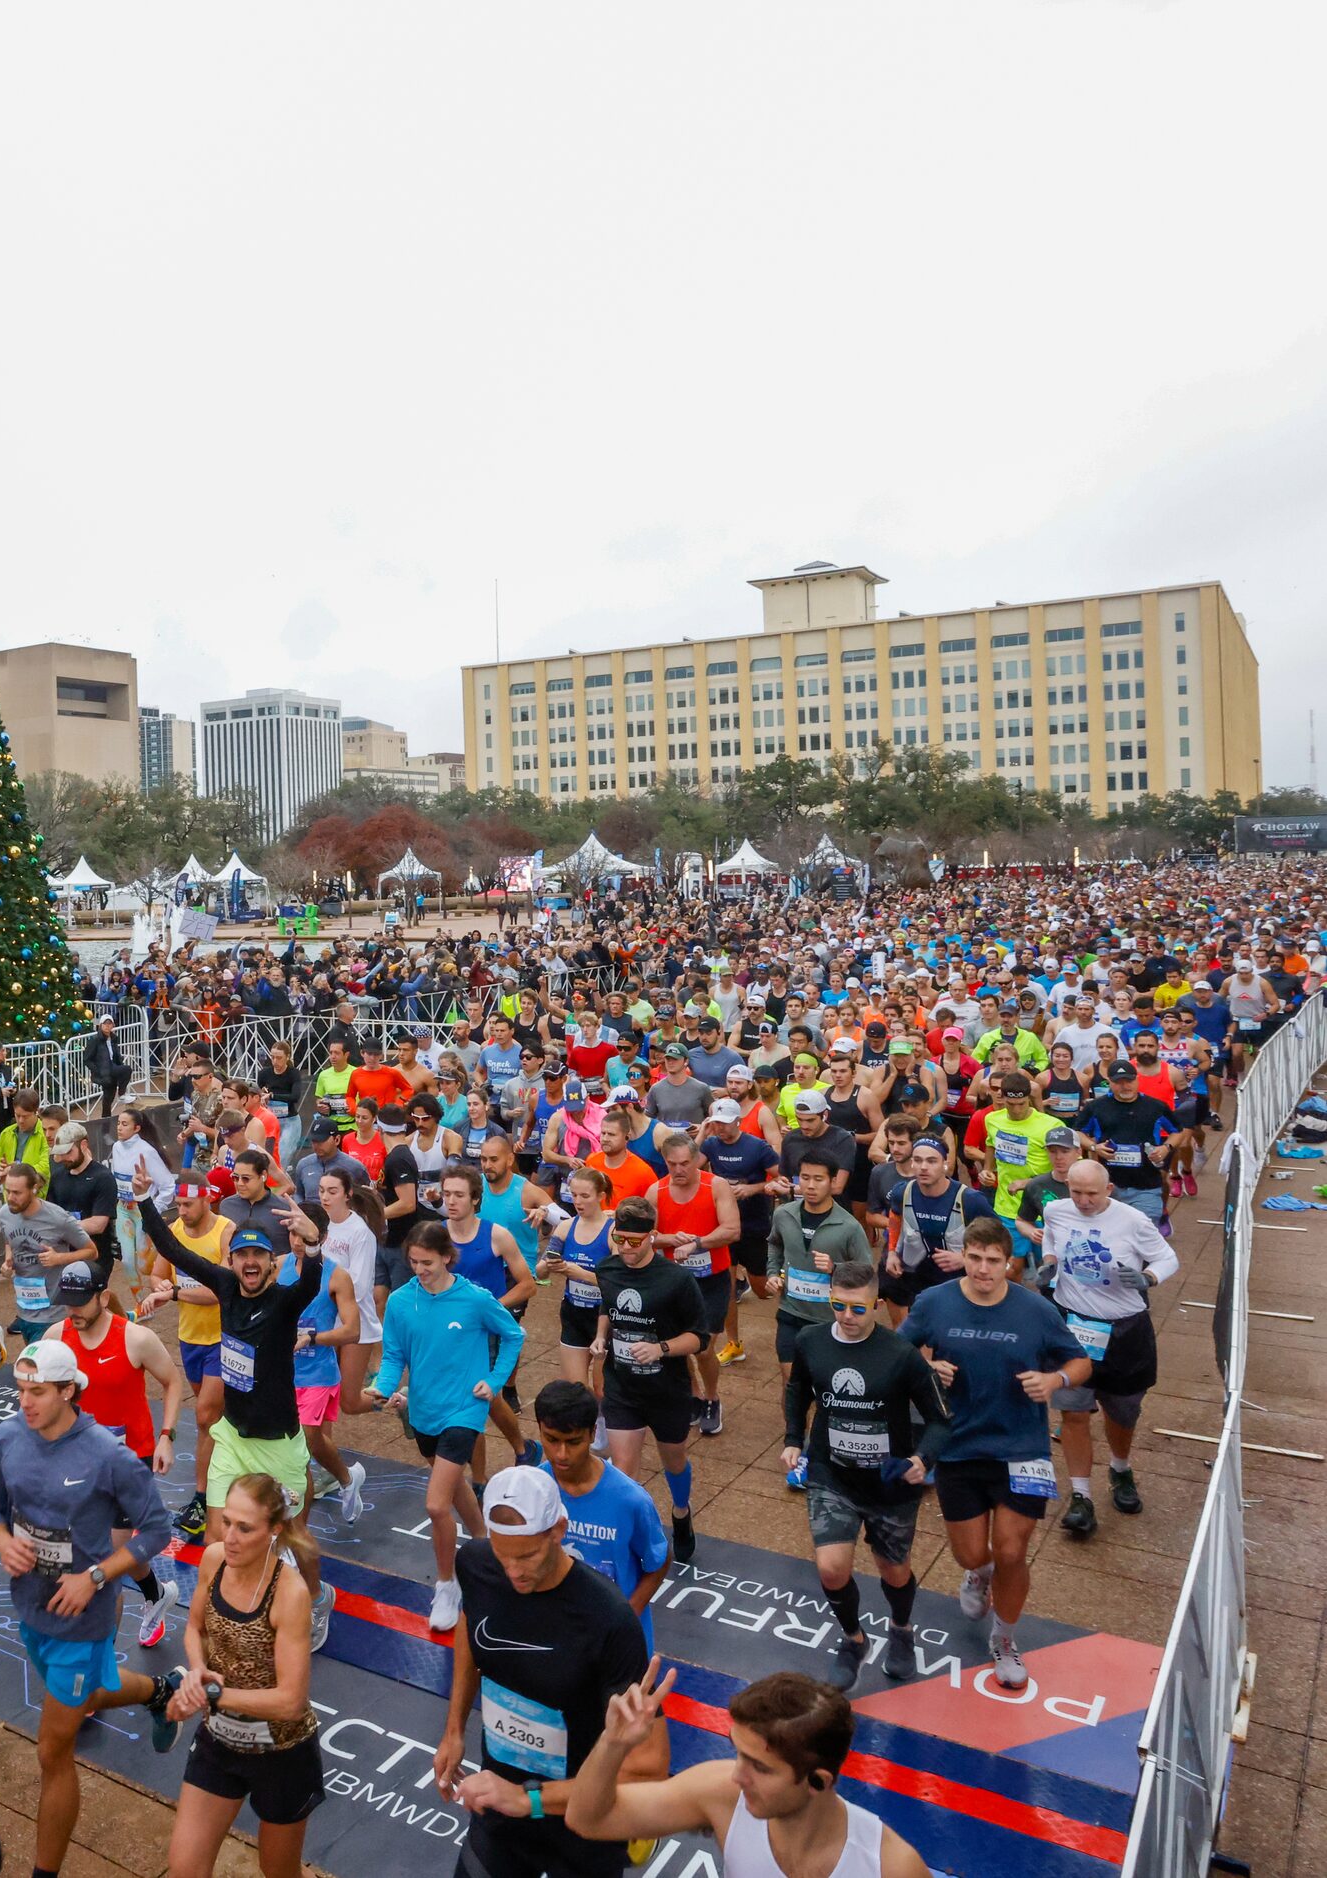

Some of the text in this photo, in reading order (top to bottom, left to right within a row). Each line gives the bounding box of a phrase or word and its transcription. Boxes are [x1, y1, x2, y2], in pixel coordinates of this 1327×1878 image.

[931, 1214, 948, 1222] EIGHT
[802, 1287, 821, 1295] 1844
[1078, 1333, 1096, 1344] 837
[821, 1391, 885, 1411] Paramount+
[838, 1440, 879, 1451] A 35230
[1019, 1465, 1029, 1474] A
[494, 1719, 505, 1734] A
[508, 1725, 546, 1749] 2303
